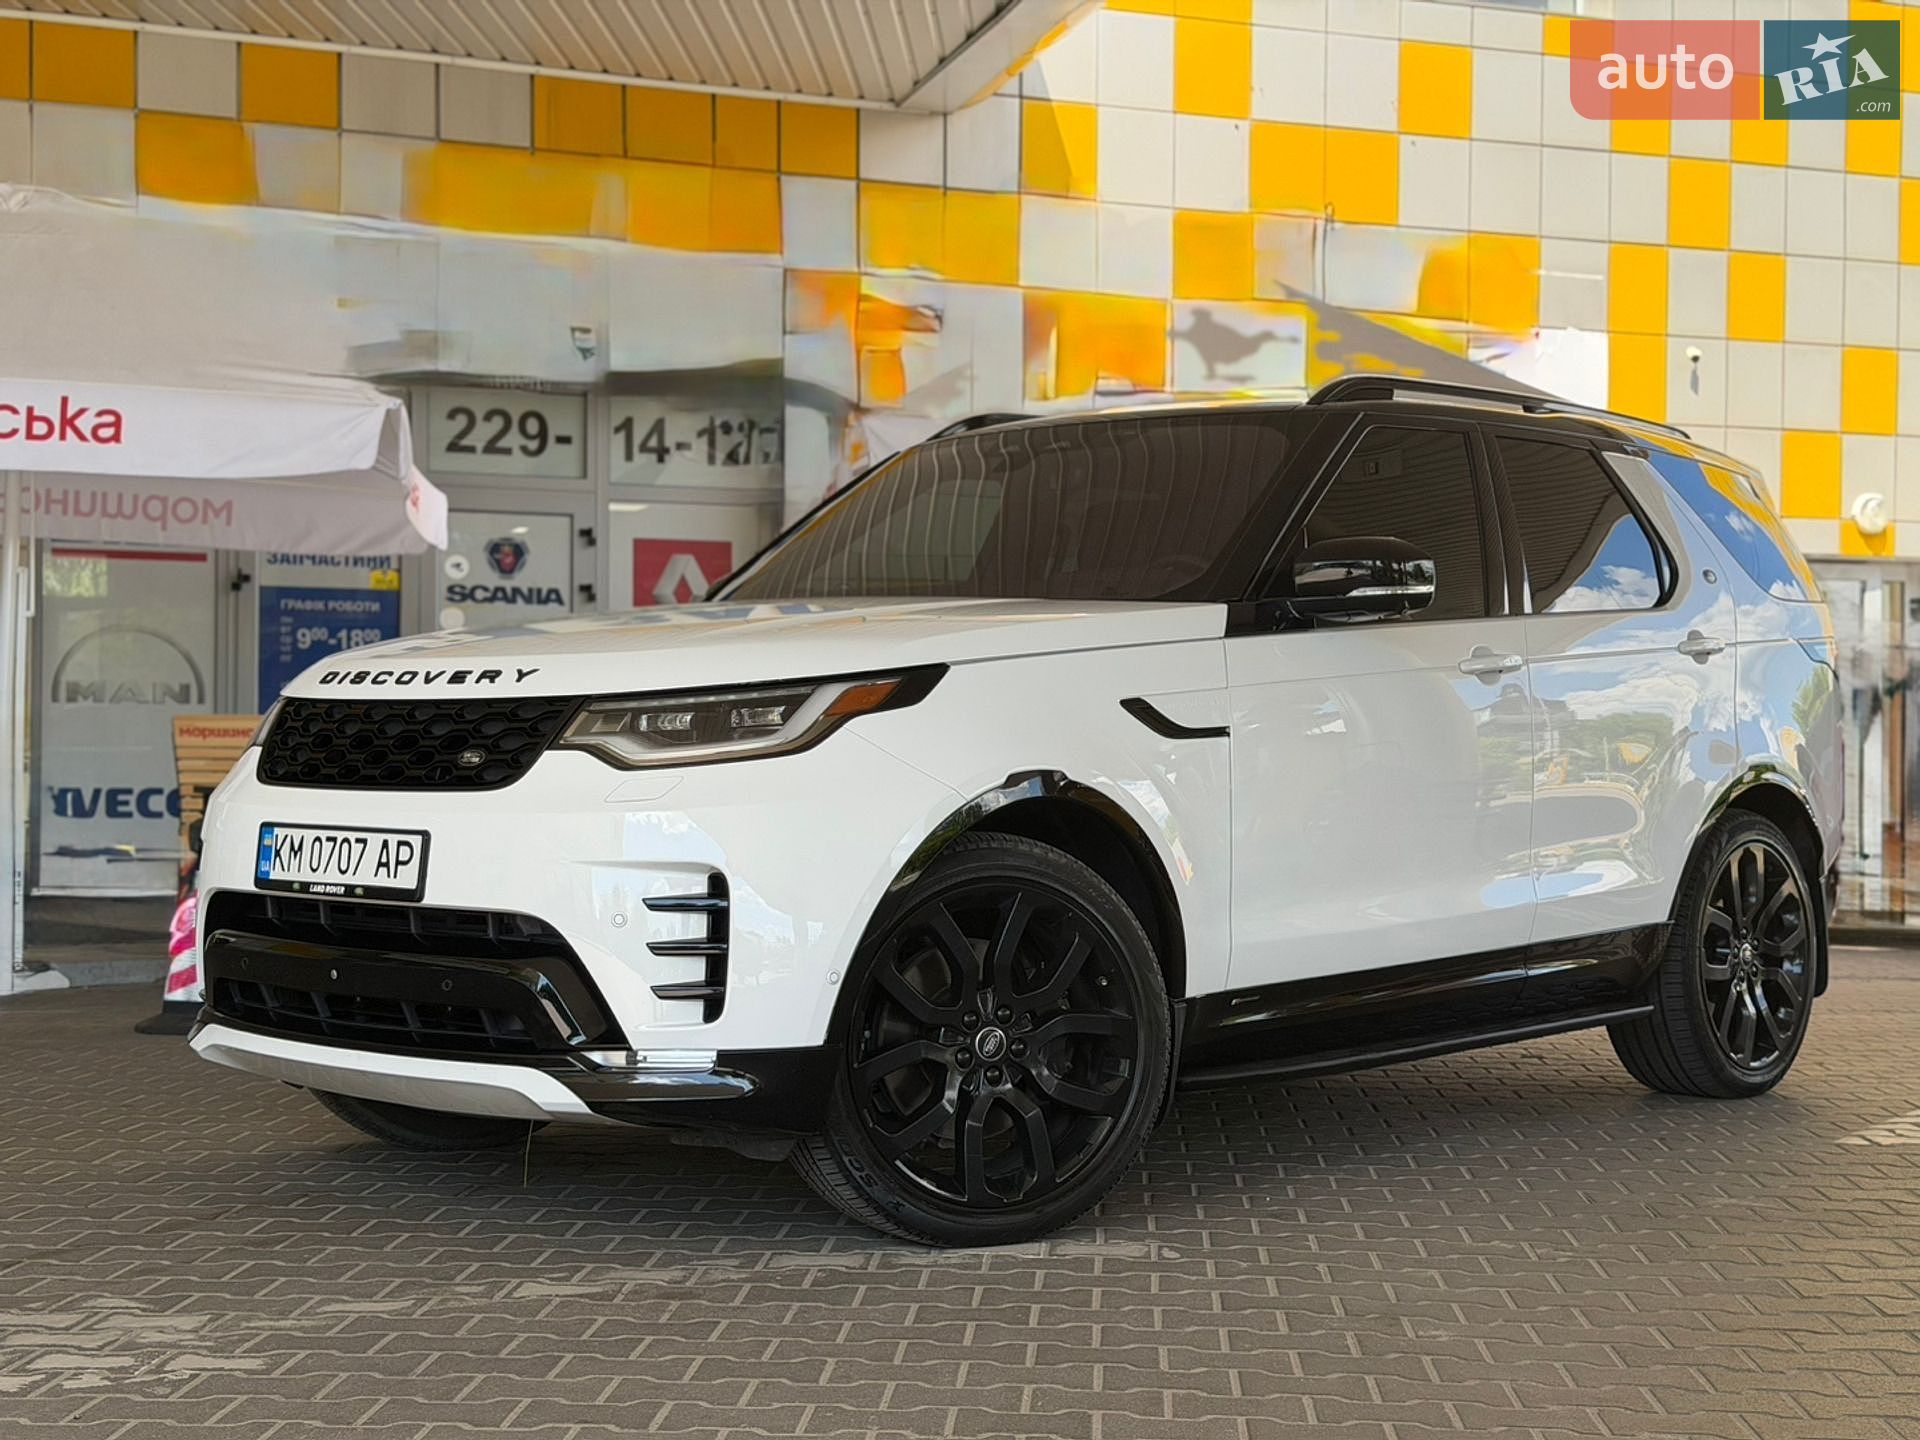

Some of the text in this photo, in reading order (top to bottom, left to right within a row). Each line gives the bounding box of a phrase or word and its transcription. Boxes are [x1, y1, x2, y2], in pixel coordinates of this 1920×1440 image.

[446, 583, 565, 606] SCANIA
[318, 668, 540, 685] DISCOVERY
[65, 681, 191, 704] MAN
[273, 833, 415, 879] KM 0707 AP
[309, 884, 345, 895] LAND ROVER
